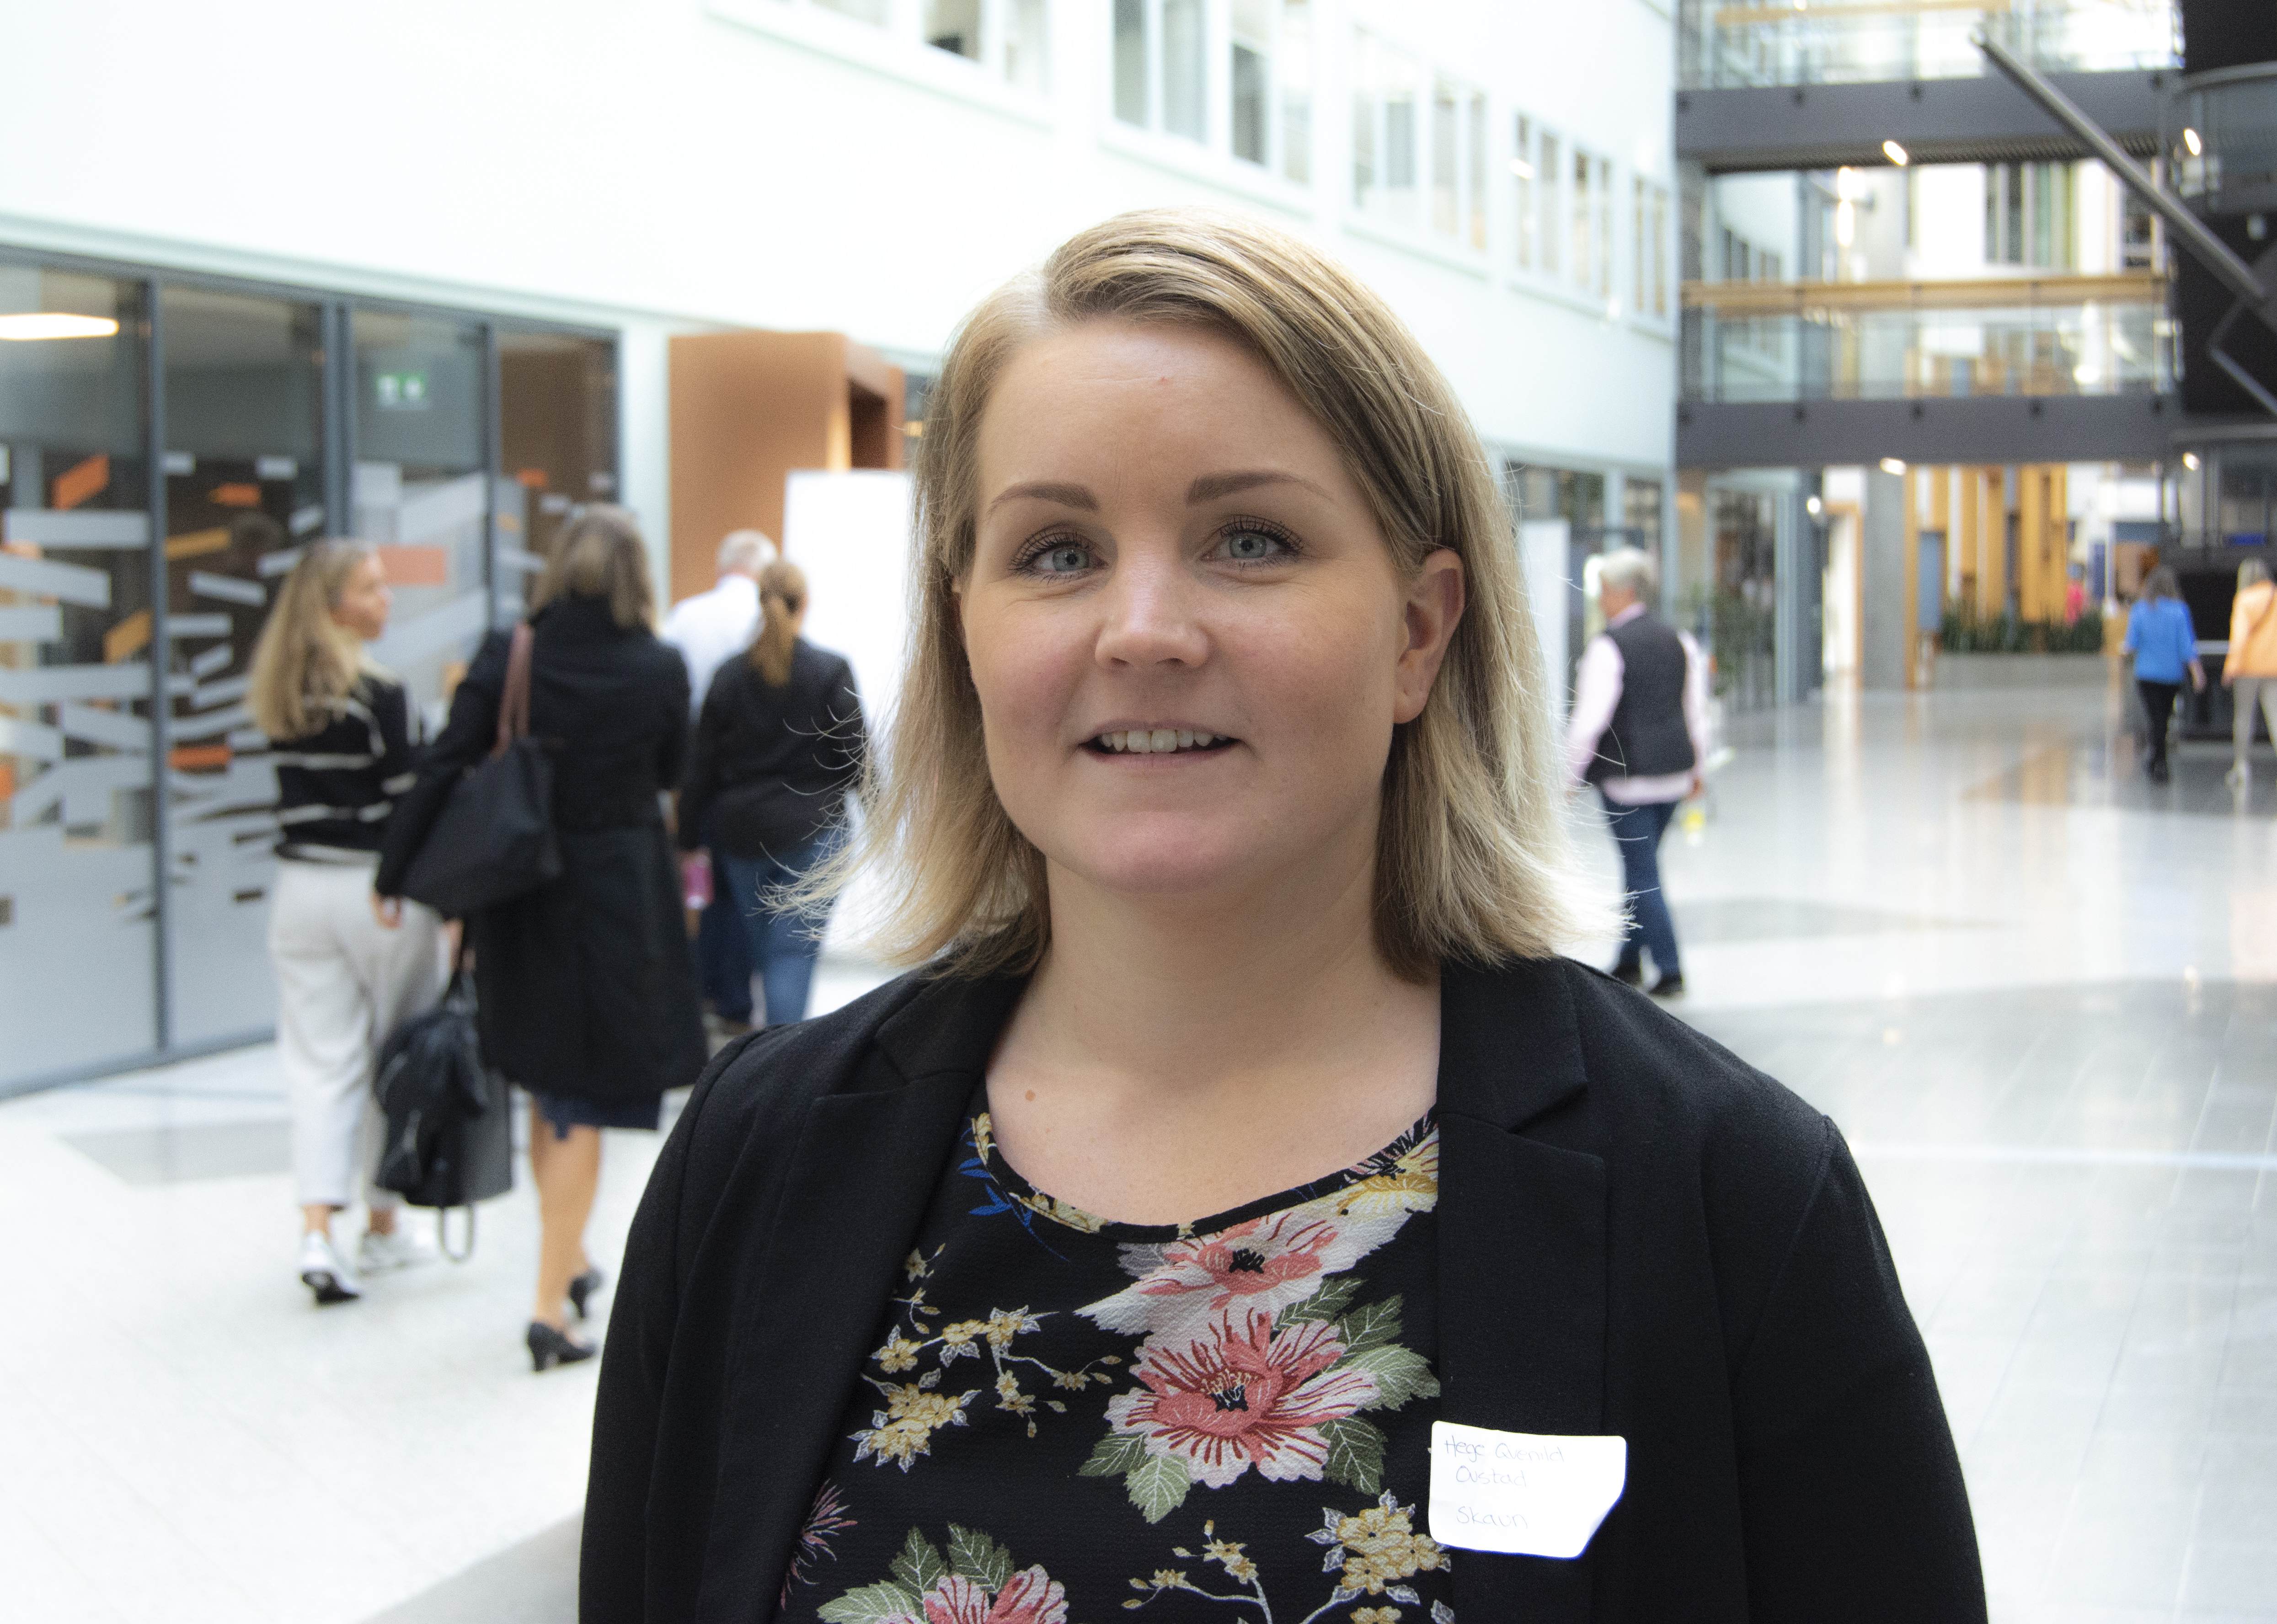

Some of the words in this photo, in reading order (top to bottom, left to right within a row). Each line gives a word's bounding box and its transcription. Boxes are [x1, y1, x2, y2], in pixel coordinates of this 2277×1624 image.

[1443, 1435, 1485, 1463] Hege
[1495, 1442, 1565, 1463] Qvenild
[1456, 1506, 1528, 1529] Skaun
